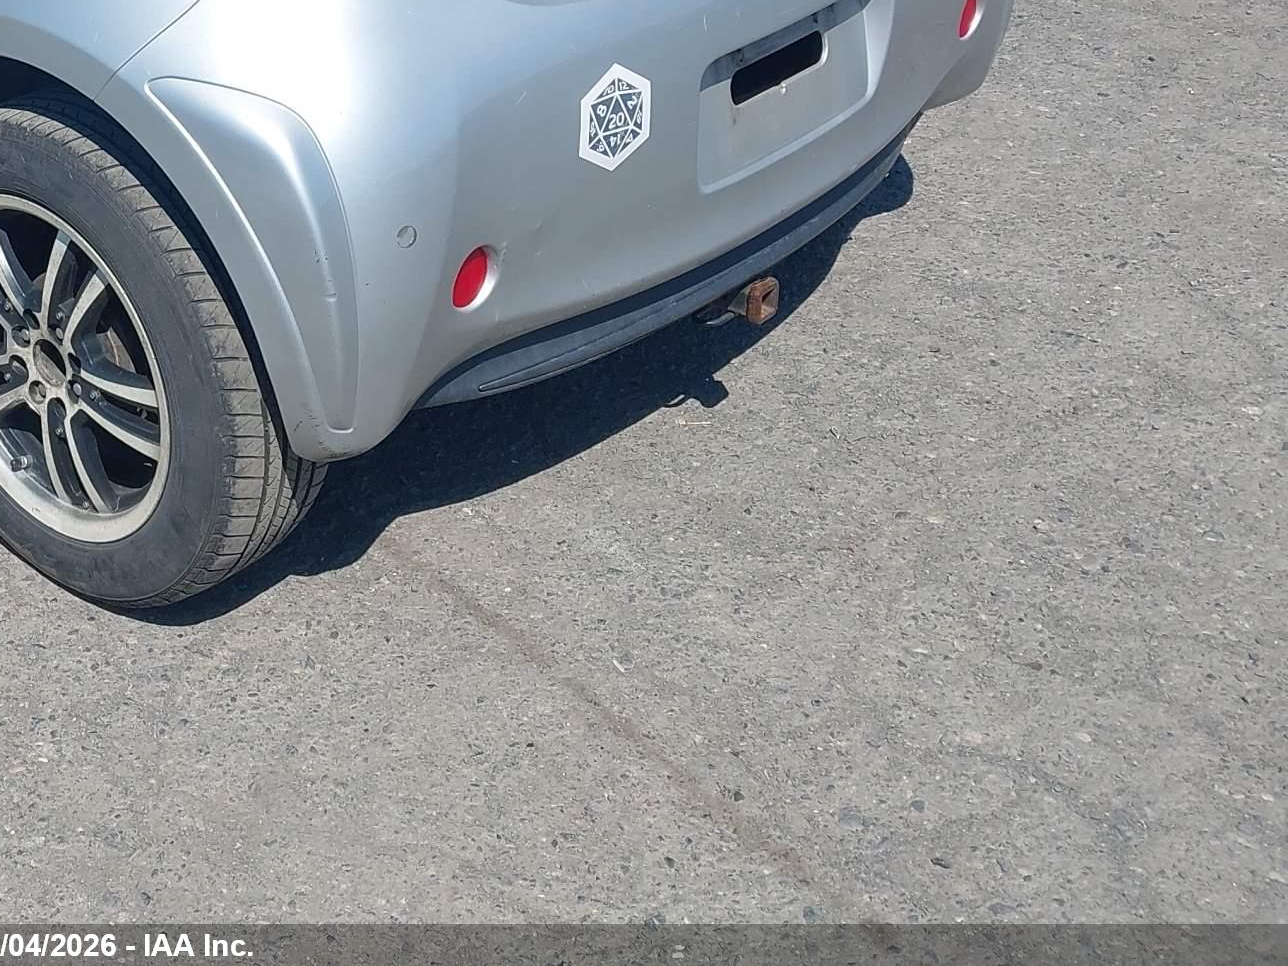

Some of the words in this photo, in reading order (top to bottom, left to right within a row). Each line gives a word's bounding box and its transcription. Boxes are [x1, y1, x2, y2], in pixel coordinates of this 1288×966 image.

[619, 81, 629, 91] 12
[627, 95, 638, 110] 2
[597, 104, 607, 117] 8
[609, 112, 625, 129] 20
